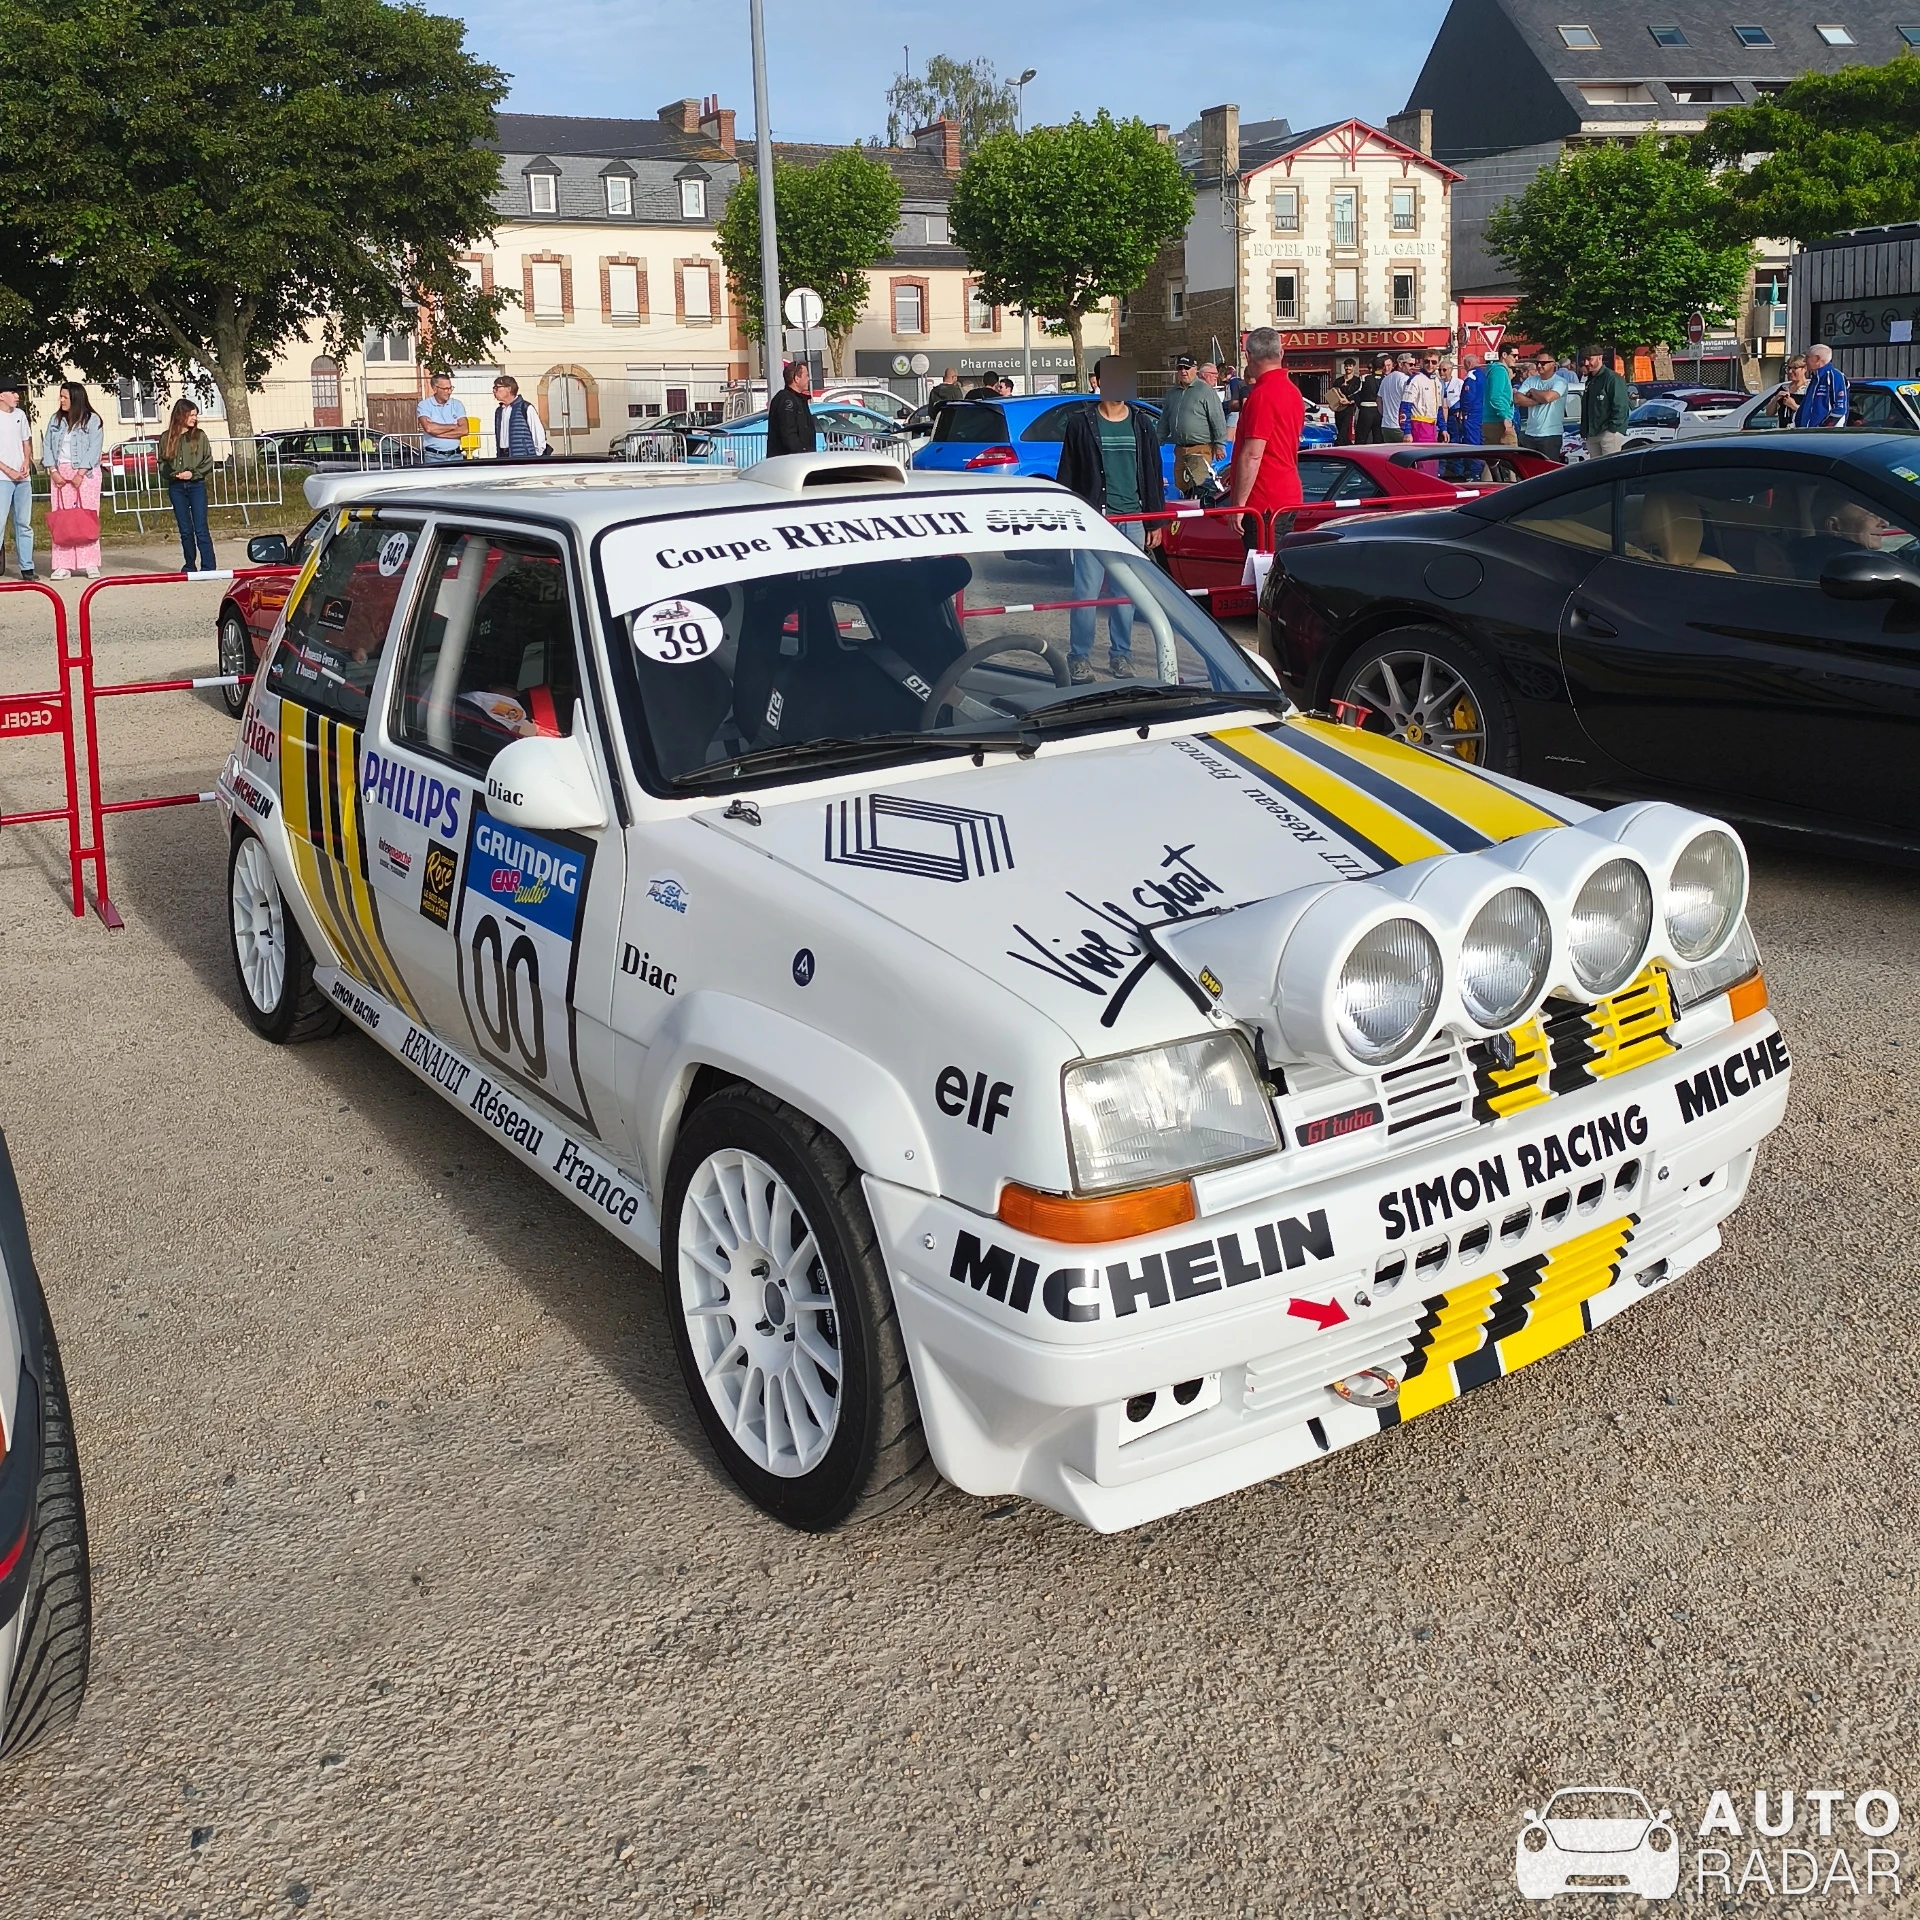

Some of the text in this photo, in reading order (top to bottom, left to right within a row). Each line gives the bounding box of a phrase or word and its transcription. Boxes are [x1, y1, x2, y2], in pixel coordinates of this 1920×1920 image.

[1253, 242, 1436, 257] HOTEL DE LA GARE
[1336, 330, 1427, 346] BRETON
[960, 357, 1021, 369] Pharmacie
[1041, 356, 1051, 368] la
[382, 541, 405, 567] 343
[655, 508, 1087, 570] Coupe RENAULT sport
[653, 622, 709, 660] 39
[242, 701, 275, 763] Diac
[766, 691, 783, 727] GT2
[1170, 740, 1242, 780] France
[232, 774, 274, 820] MICHELIN
[363, 751, 461, 839] PHILIPS
[487, 777, 524, 807] Diac
[1242, 787, 1328, 844] Réseau
[476, 825, 577, 895] GRUNDIG
[490, 868, 551, 904] CAR audio
[664, 885, 681, 900] ASA
[620, 942, 678, 996] Diac
[1006, 923, 1140, 996] Vive
[332, 981, 380, 1029] SIMON RACING
[1200, 971, 1221, 996] OMP
[935, 1064, 1014, 1135] elf
[1674, 1029, 1791, 1125] MICHE
[400, 1026, 640, 1226] RENAULT Réseau France
[1308, 1110, 1374, 1144] GT turbo
[1378, 1103, 1649, 1241] SIMON RACING
[949, 1208, 1336, 1323] MICHELIN
